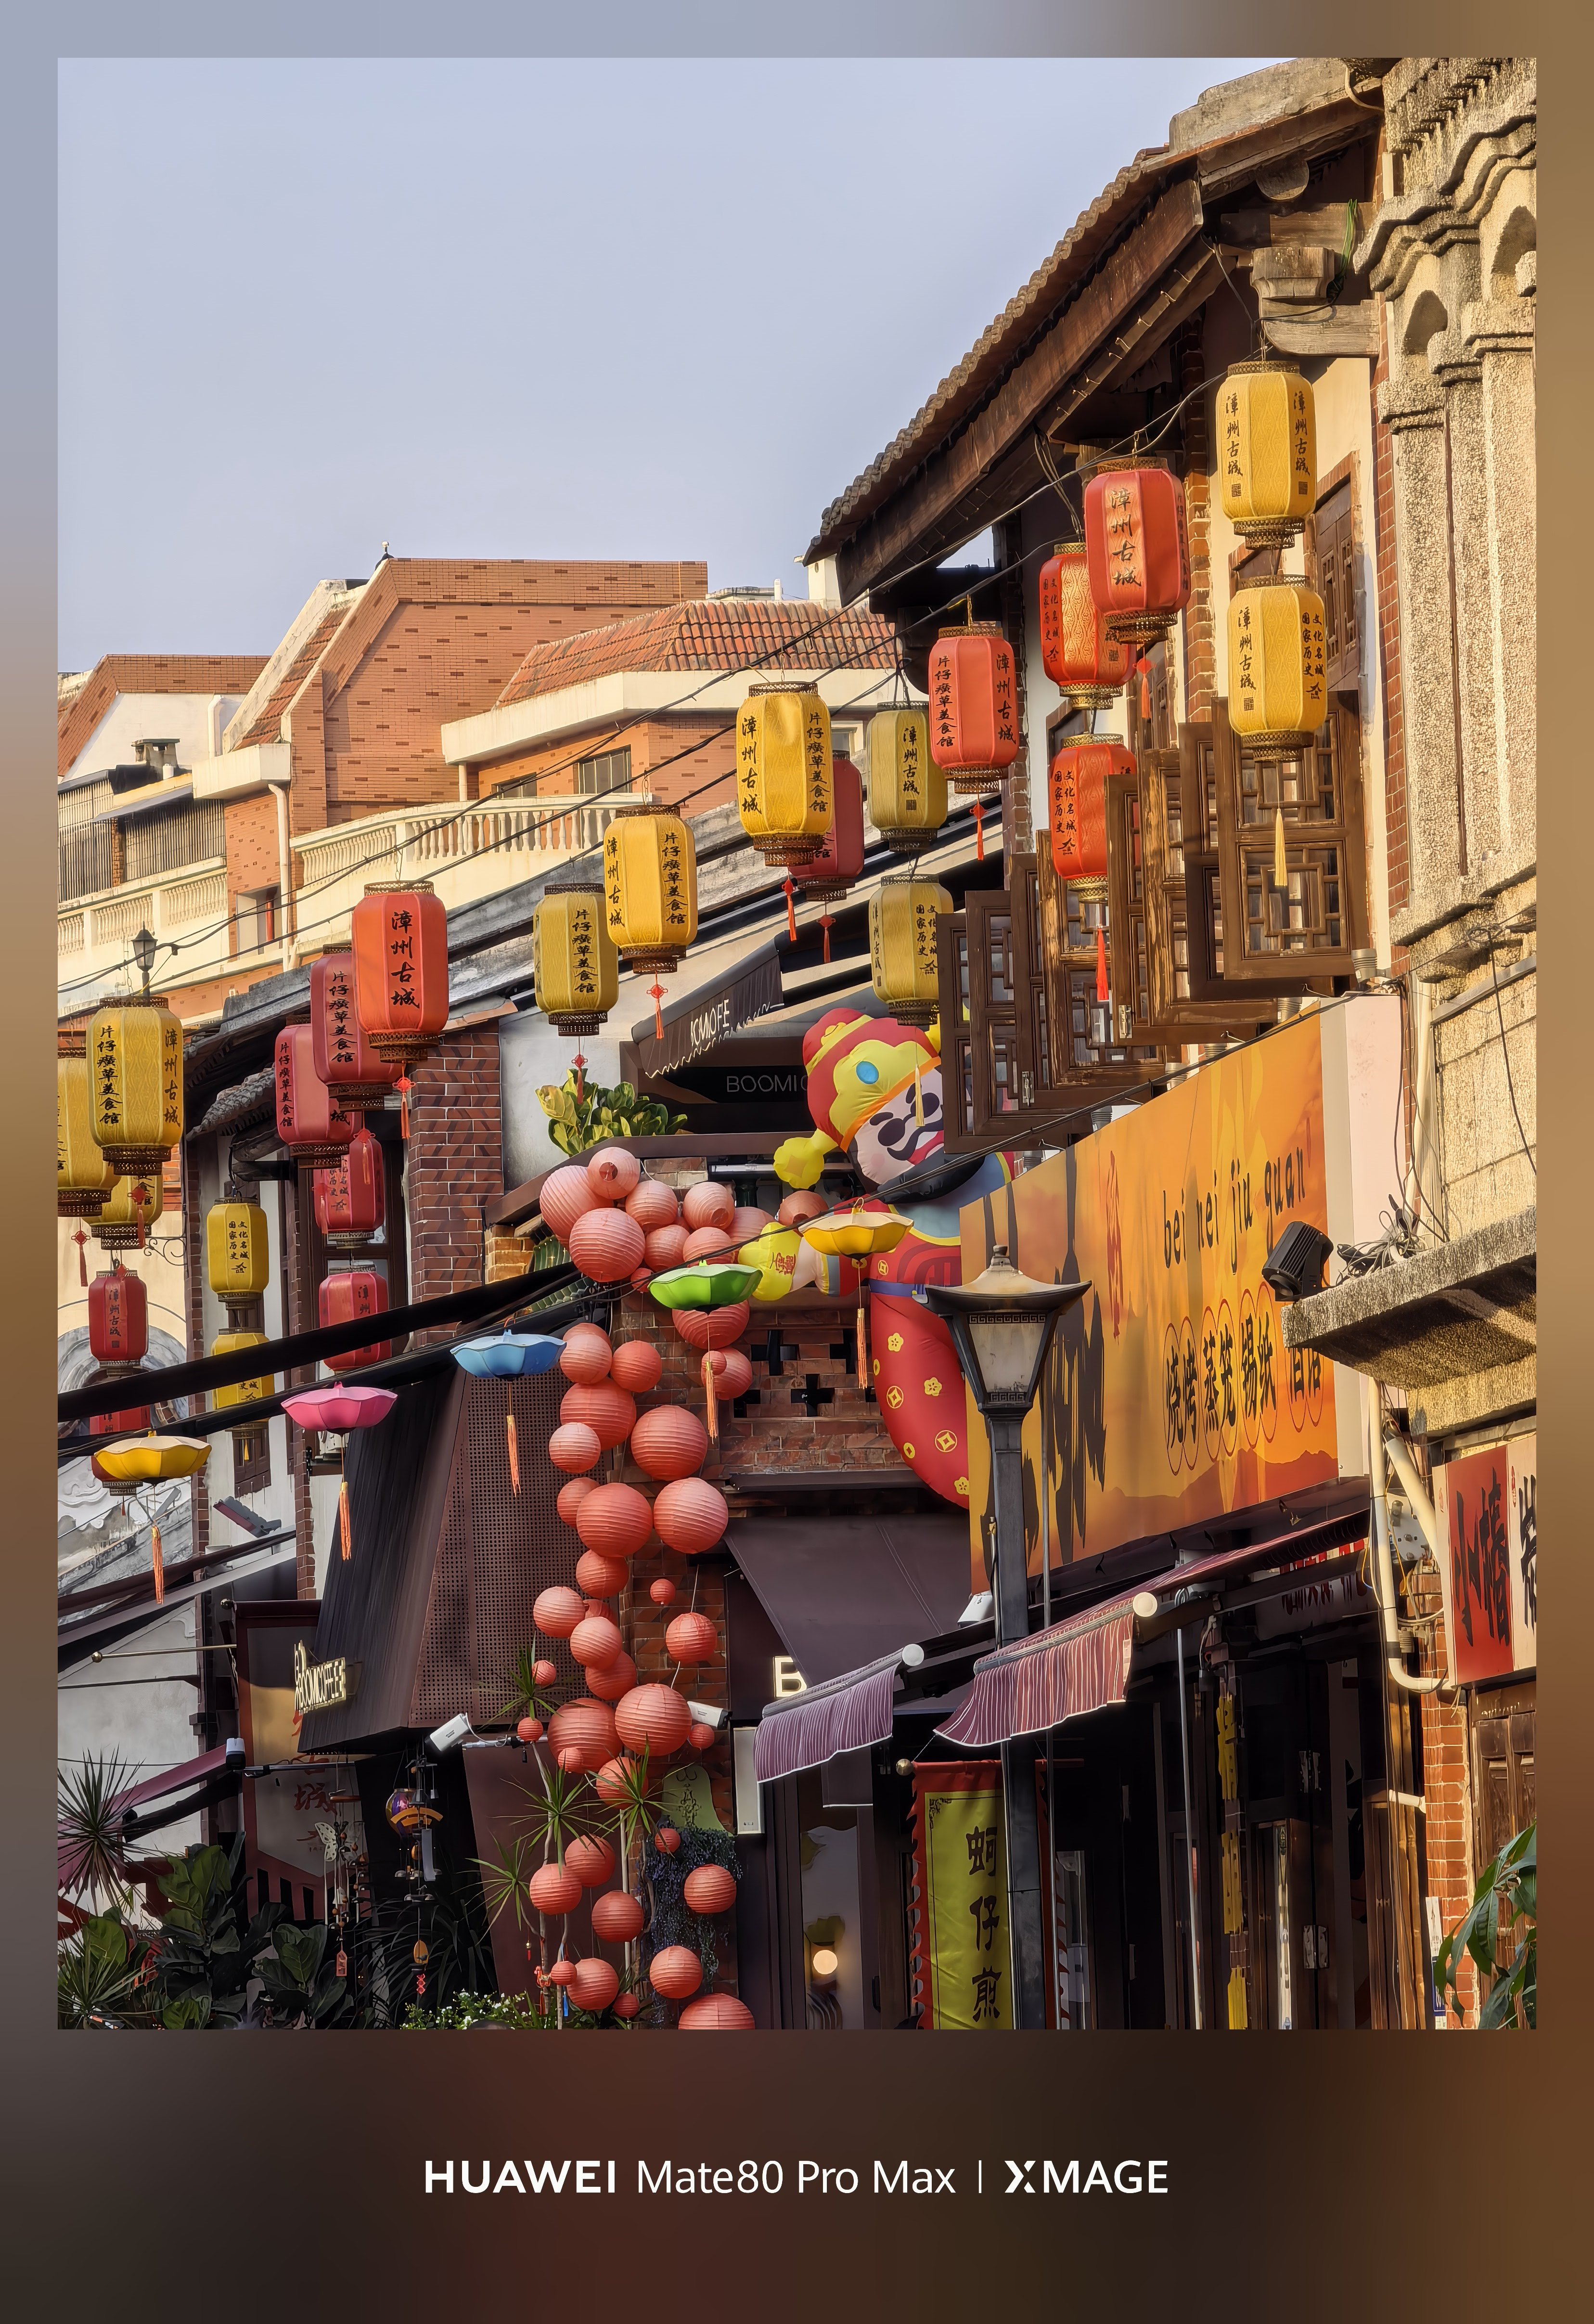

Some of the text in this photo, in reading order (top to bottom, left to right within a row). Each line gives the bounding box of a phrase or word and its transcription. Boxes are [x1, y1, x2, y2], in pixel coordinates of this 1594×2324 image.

[1226, 393, 1243, 477] 漳州古城
[1294, 391, 1311, 476] 漳州古城
[1110, 488, 1142, 587] 漳州古城
[1238, 606, 1257, 690] 漳州古城
[1302, 612, 1314, 677] 国家历史
[1312, 613, 1325, 678] 文化名城
[996, 653, 1016, 745] 漳州古城
[742, 716, 762, 814] 漳州古城
[903, 726, 920, 795] 漳州古城
[1054, 771, 1065, 833] 国家历史
[1064, 770, 1077, 832] 文化名城
[606, 837, 625, 928] 漳州古城
[390, 910, 420, 1009] 漳州古城
[916, 904, 928, 956] 国家历史
[163, 1028, 181, 1127] 漳州古城
[1163, 1188, 1186, 1269] bei
[1196, 1169, 1219, 1252] nei
[1231, 1157, 1253, 1276] jiu
[1264, 1147, 1305, 1259] guan
[1166, 1338, 1198, 1449] 烧烤
[1203, 1322, 1237, 1435] 蒸笼
[1241, 1311, 1276, 1422] 锡纸
[965, 1825, 1003, 2023] 蚵仔煎
